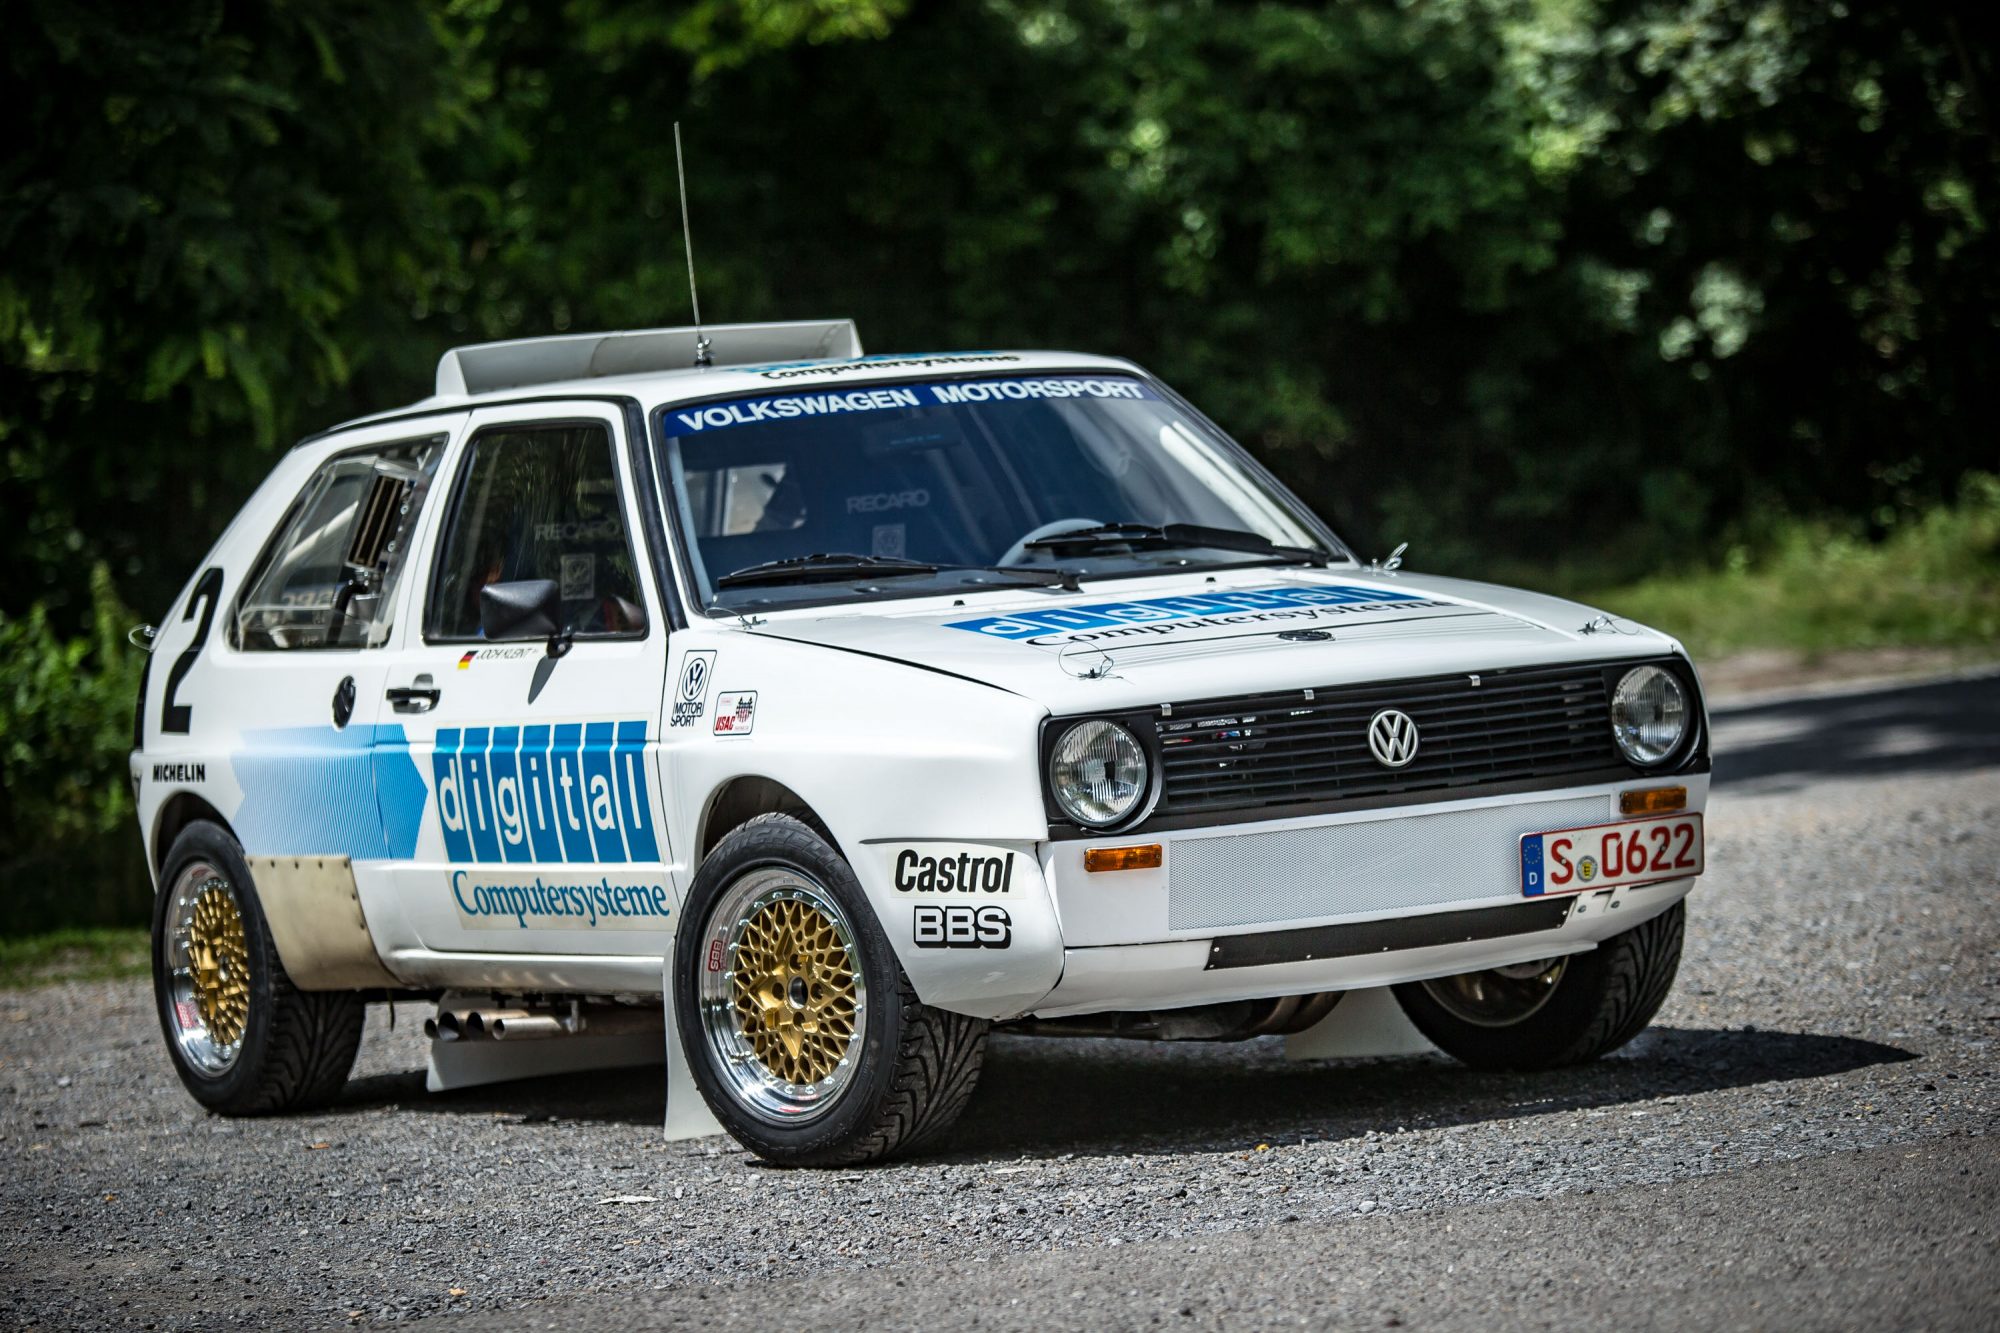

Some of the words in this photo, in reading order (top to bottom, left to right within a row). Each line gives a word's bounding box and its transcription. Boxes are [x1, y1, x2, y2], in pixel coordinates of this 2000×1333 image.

[677, 388, 920, 431] VOLKSWAGEN
[931, 379, 1146, 406] MOTORSPORT
[847, 488, 929, 515] RECARO
[978, 588, 1394, 635] digital
[1026, 600, 1462, 646] Computersysteme
[160, 567, 224, 735] 2
[670, 715, 696, 727] SPORT
[674, 702, 703, 715] MOTOR
[714, 715, 737, 731] USAC
[153, 764, 206, 783] MICHELIN
[438, 753, 643, 846] digital
[895, 849, 1014, 893] Castrol
[1550, 839, 1574, 884] S
[1601, 823, 1696, 878] 0622
[452, 870, 670, 928] Computersysteme
[1528, 872, 1539, 885] D
[914, 905, 1012, 949] BBS
[709, 941, 722, 971] BBS
